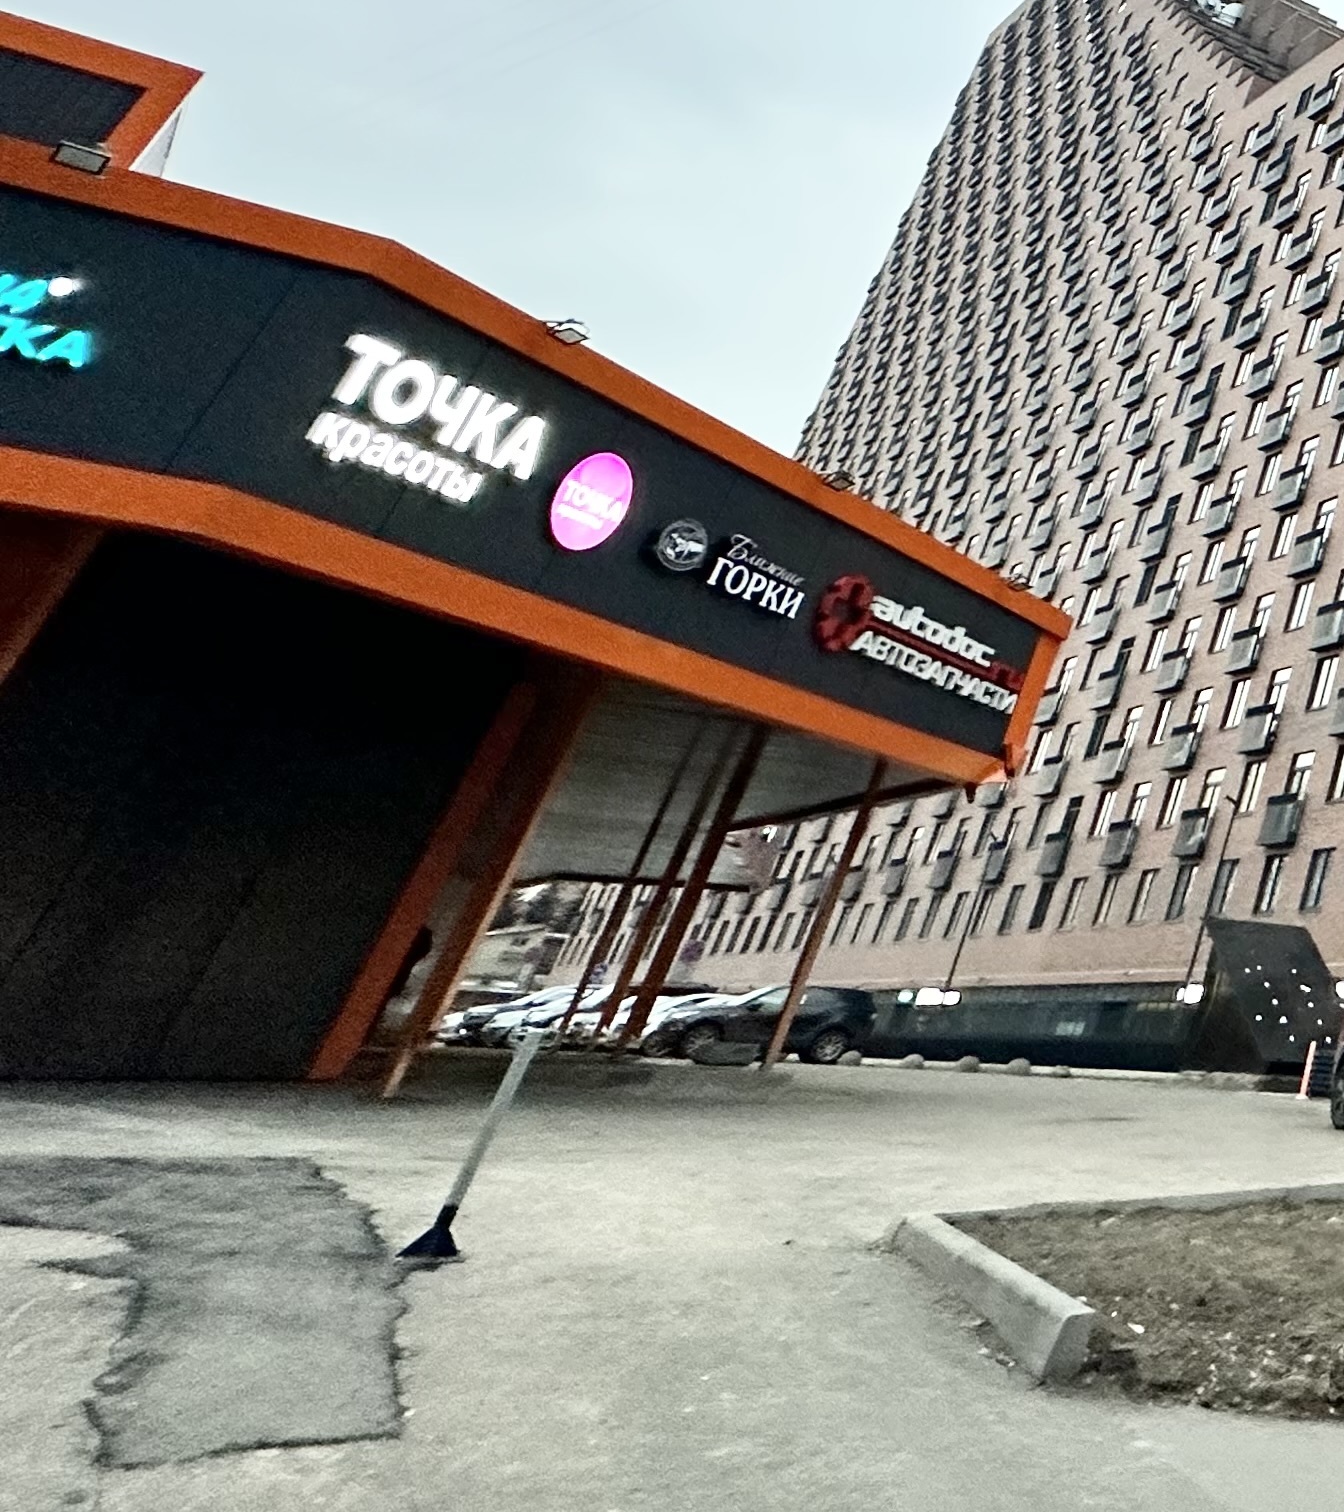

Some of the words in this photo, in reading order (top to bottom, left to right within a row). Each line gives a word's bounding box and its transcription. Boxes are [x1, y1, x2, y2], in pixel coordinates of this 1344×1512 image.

[332, 333, 547, 481] ТОЧКА
[305, 411, 484, 504] красоты
[706, 556, 806, 620] ГОРКИ
[727, 533, 805, 587] Ближние
[848, 630, 1019, 715] АВТОЗАПЧАСТИ
